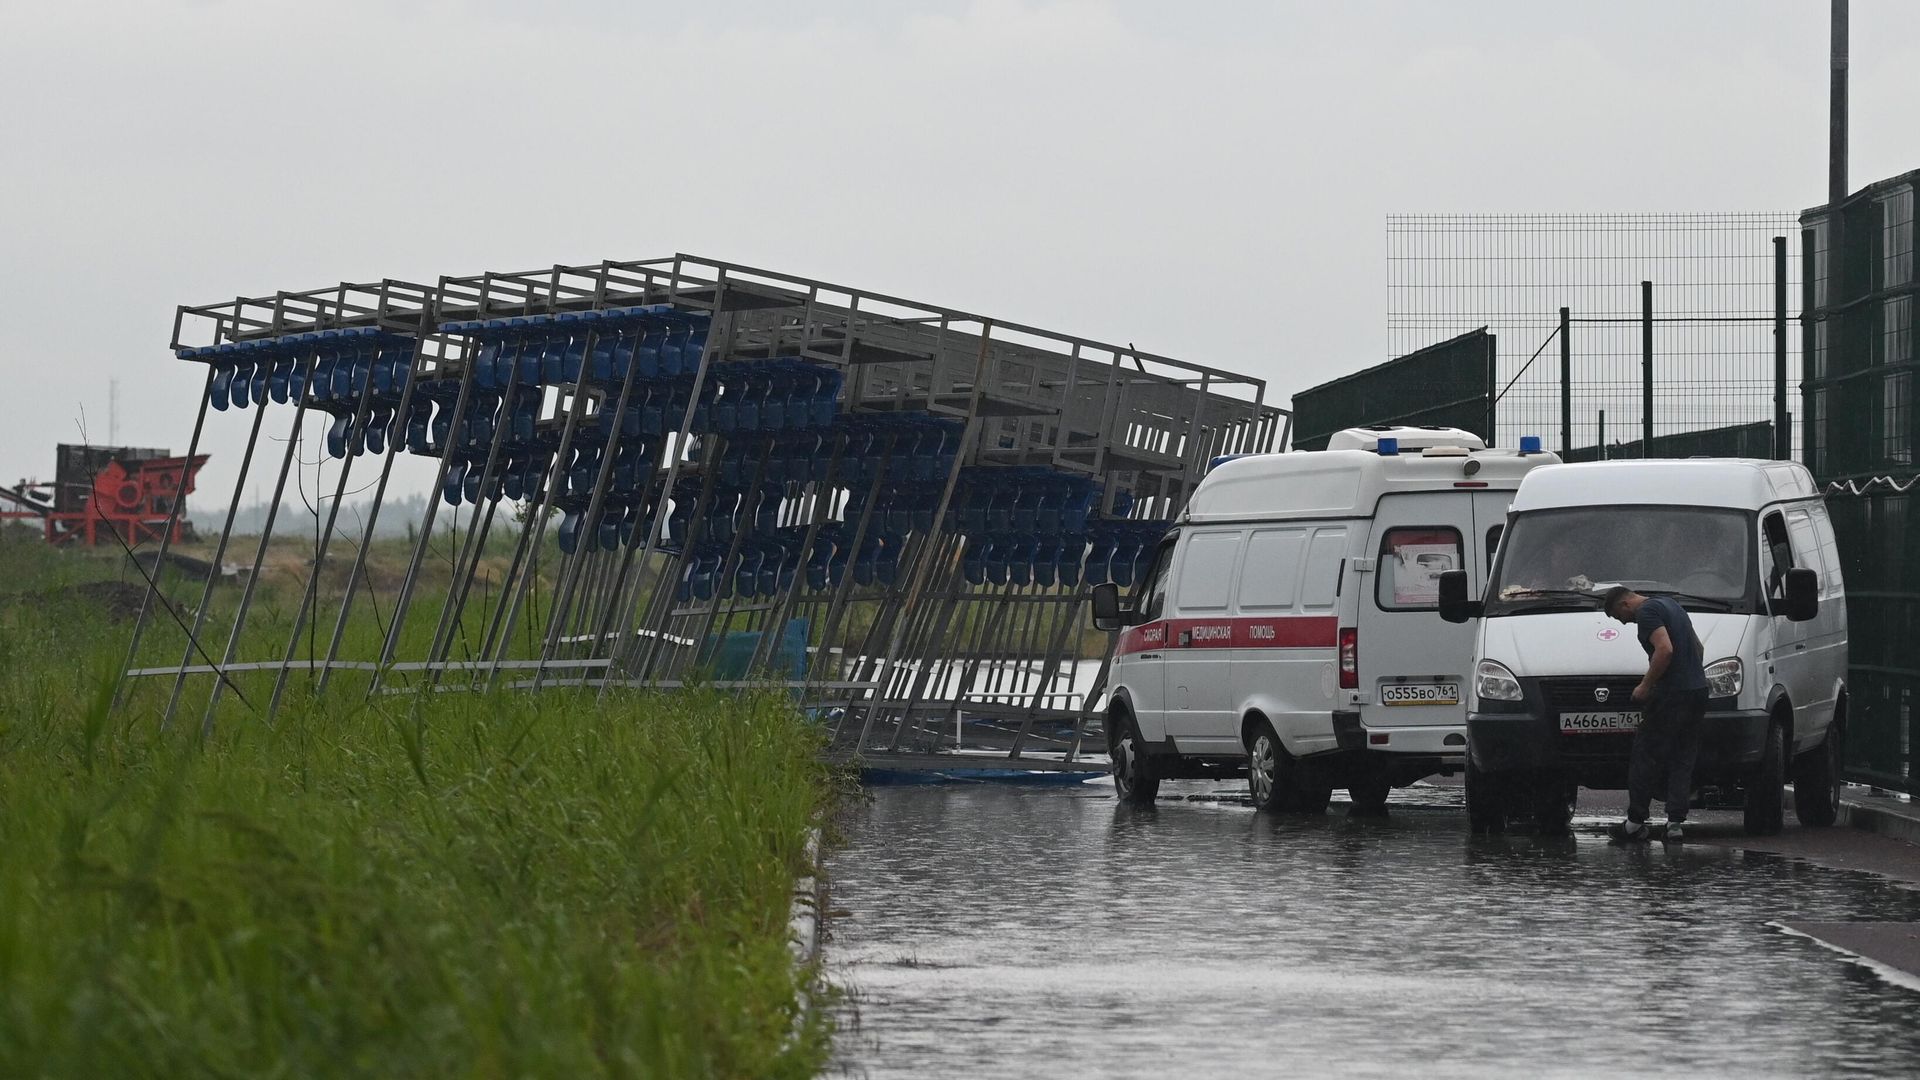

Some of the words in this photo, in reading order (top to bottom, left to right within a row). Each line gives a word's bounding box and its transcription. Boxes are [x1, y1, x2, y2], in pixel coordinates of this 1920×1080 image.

[1144, 628, 1162, 642] СКОРАЯ
[1192, 626, 1231, 642] МЕДИЦИНСКАЯ
[1249, 625, 1275, 640] ПОМОЩЬ
